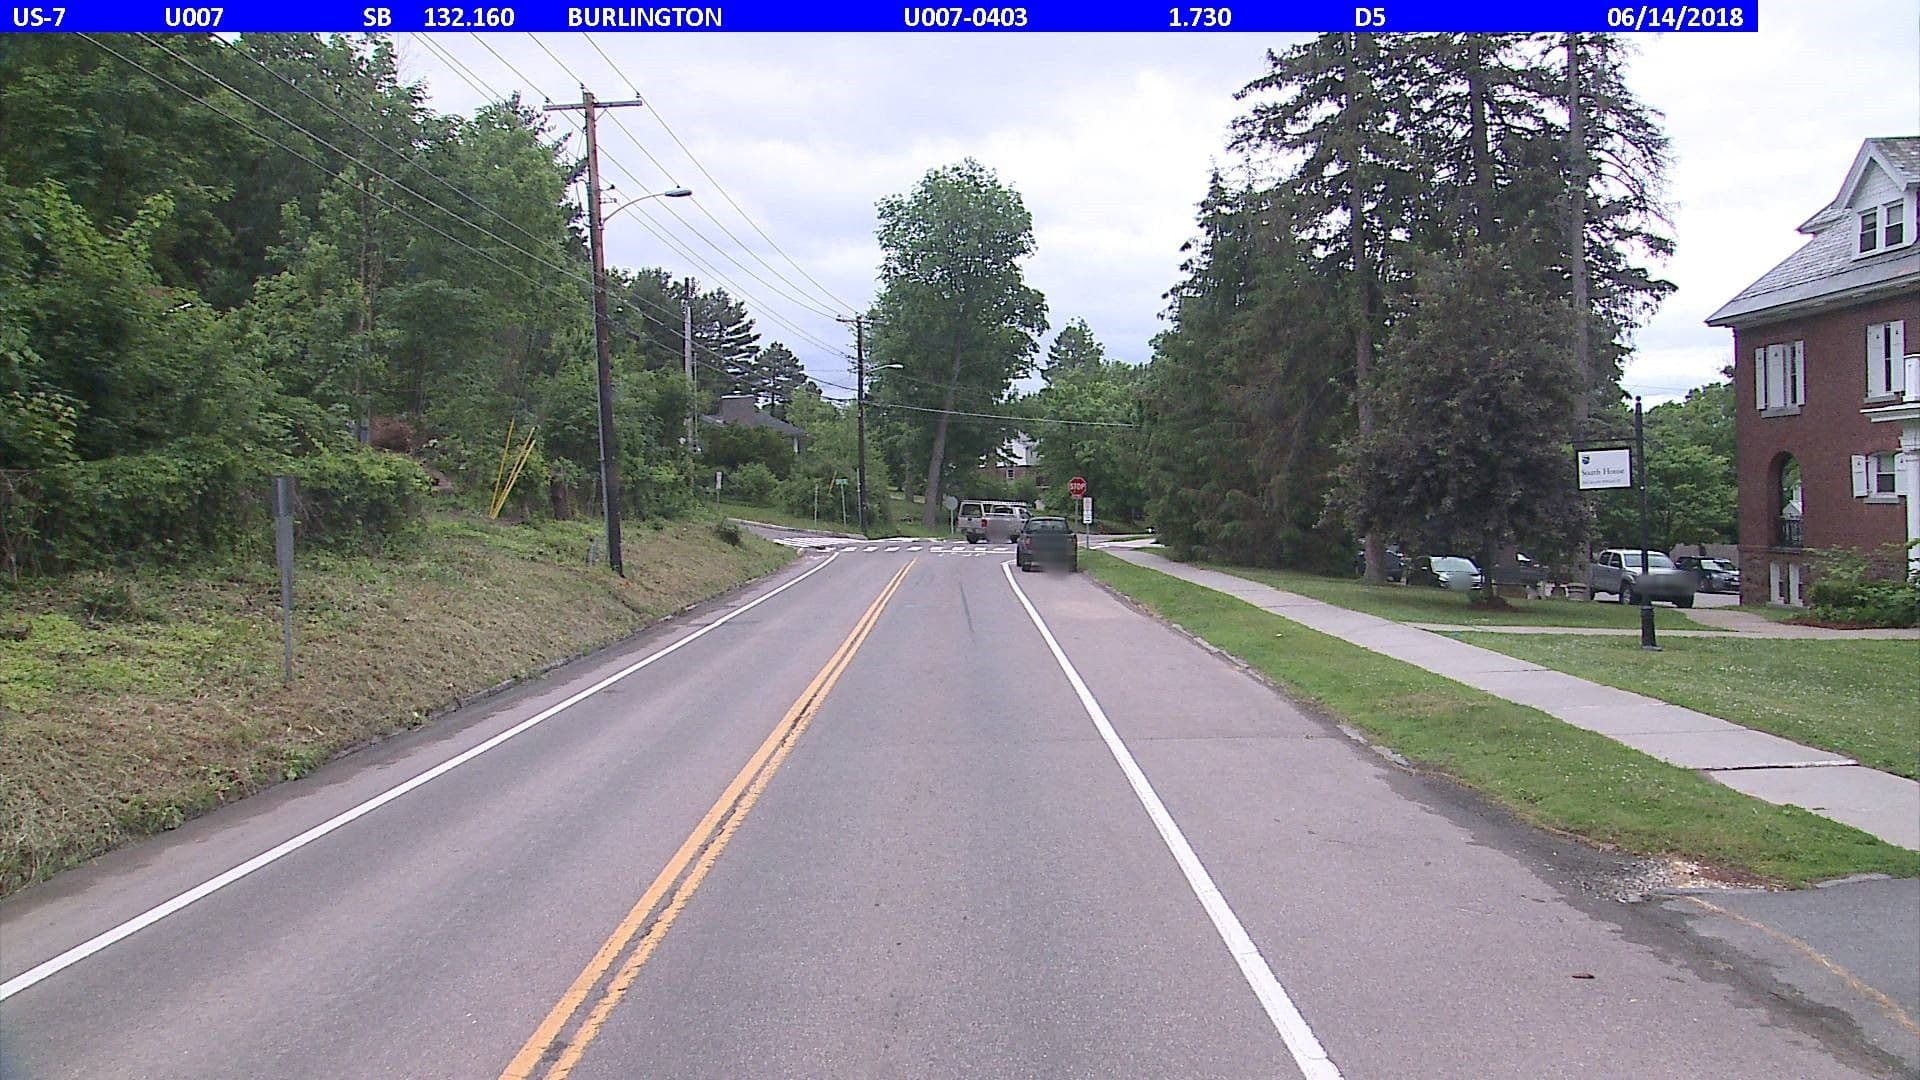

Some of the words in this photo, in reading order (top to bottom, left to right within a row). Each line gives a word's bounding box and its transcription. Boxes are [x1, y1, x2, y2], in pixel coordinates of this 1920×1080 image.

[1582, 468, 1601, 476] South
[1602, 467, 1625, 475] House
[1070, 482, 1086, 491] STOP
